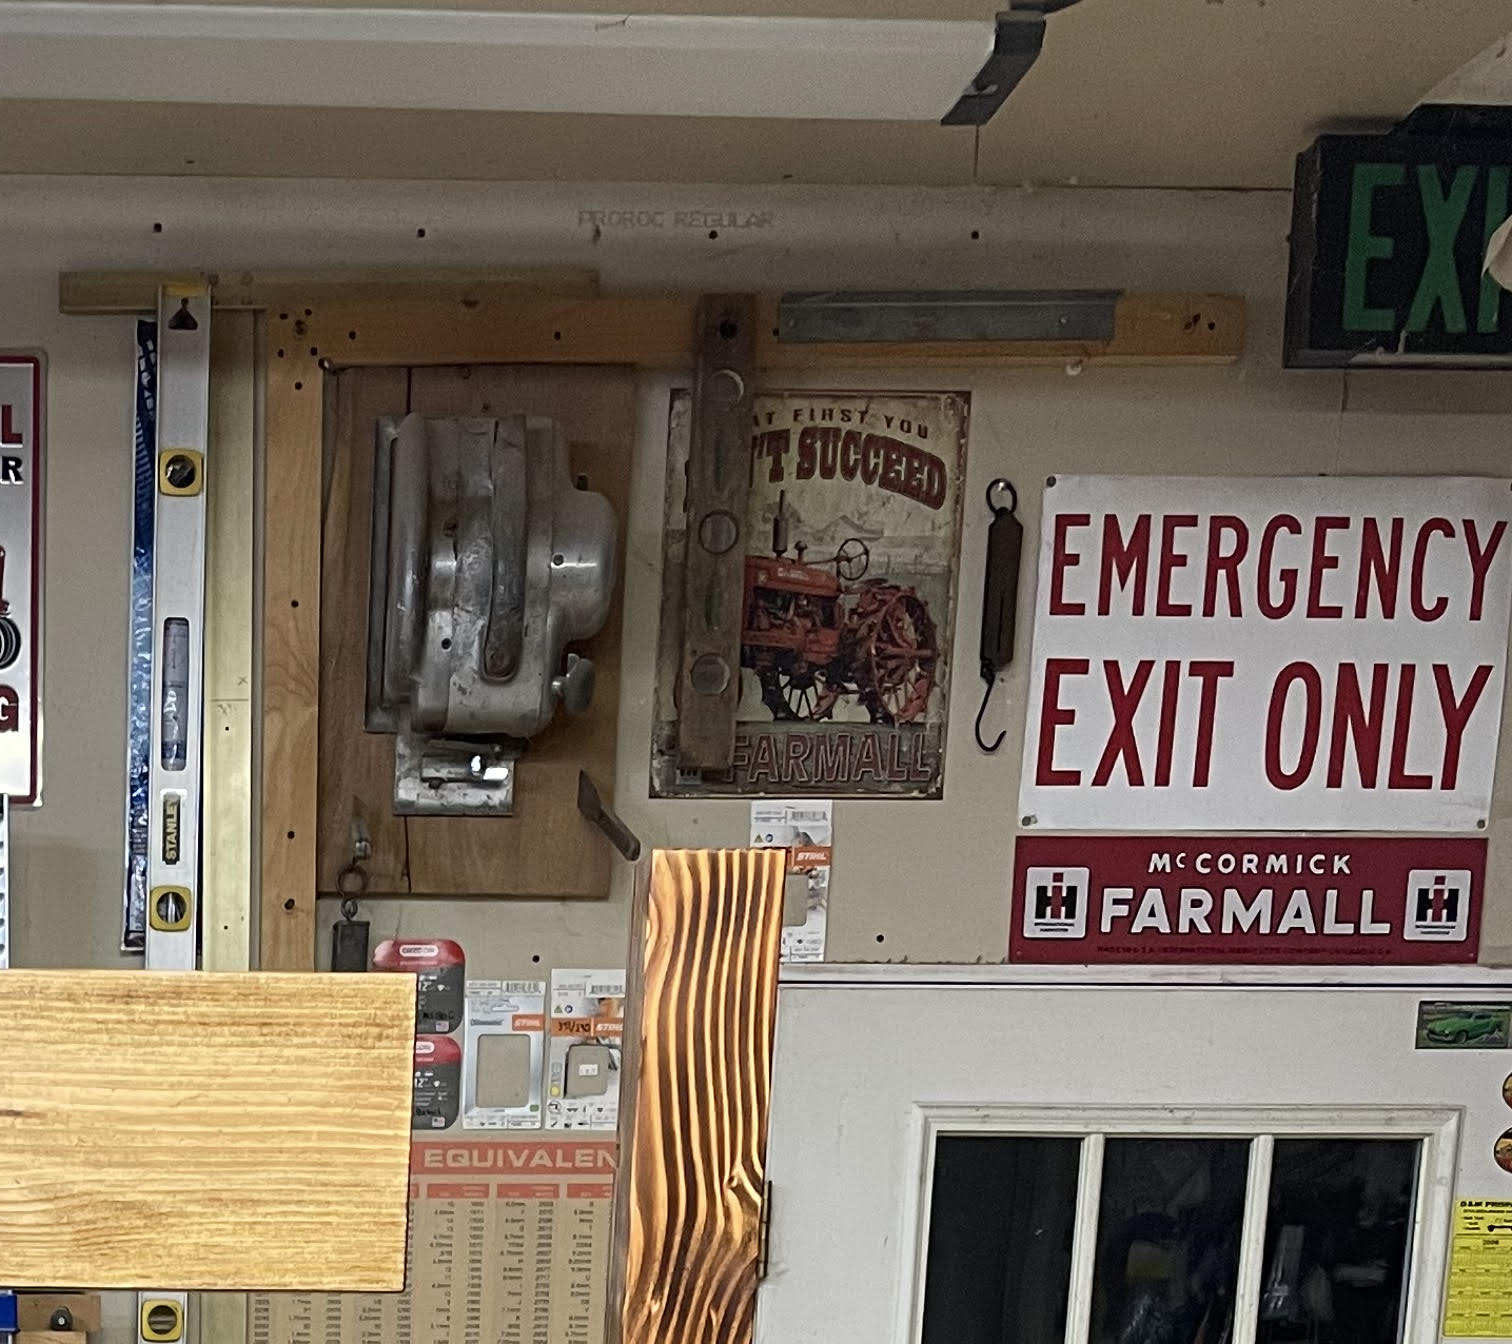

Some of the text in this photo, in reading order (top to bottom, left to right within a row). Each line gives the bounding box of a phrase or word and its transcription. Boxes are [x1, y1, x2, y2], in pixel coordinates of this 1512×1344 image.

[1341, 163, 1512, 333] EXI
[793, 408, 869, 424] FIRST
[884, 415, 929, 439] YOU
[796, 427, 947, 511] SUCCEED
[1049, 513, 1508, 622] EMERGENCY
[1035, 658, 1494, 790] EXIT ONLY
[164, 798, 178, 861] STANLEY
[1100, 888, 1390, 934] FARMALL
[423, 1148, 618, 1169] EQUIVALEN
